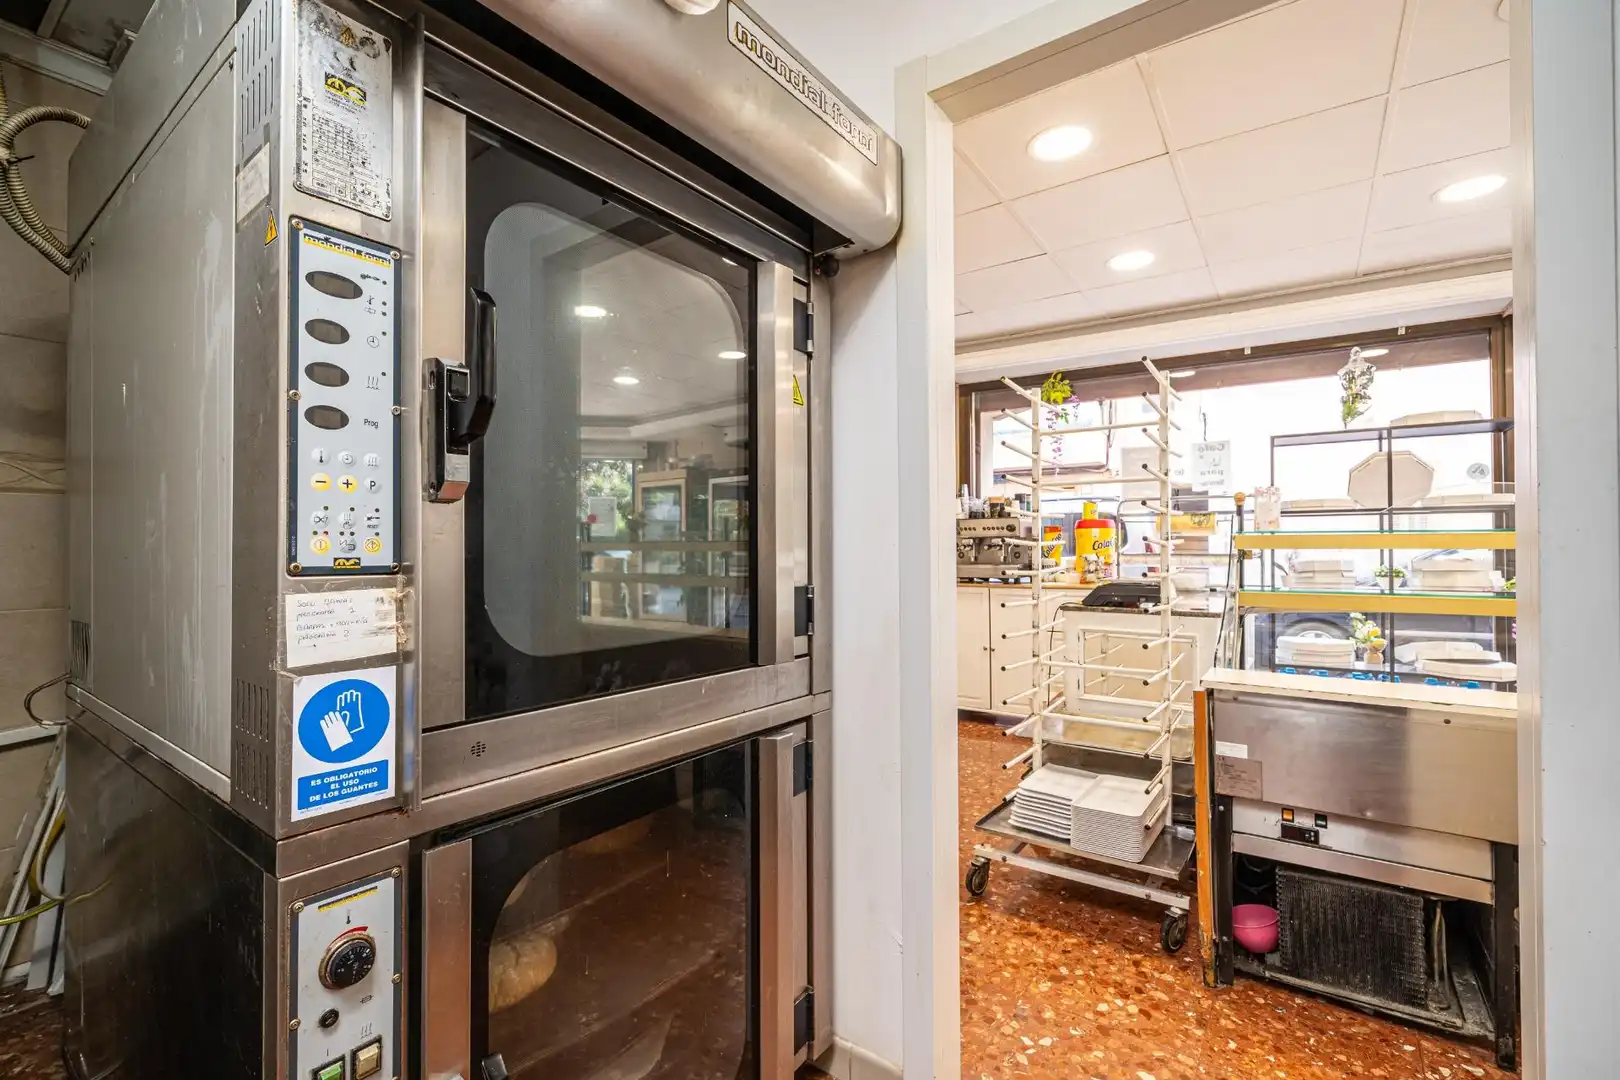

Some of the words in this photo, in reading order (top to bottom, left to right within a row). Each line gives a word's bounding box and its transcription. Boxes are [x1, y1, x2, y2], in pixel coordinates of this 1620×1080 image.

[736, 21, 827, 114] mondial
[364, 419, 379, 430] Prog
[369, 480, 377, 491] P
[323, 766, 378, 783] OBLIGATORIO
[342, 778, 359, 787] USO
[323, 790, 339, 799] LOS
[341, 781, 378, 795] GUANTES
